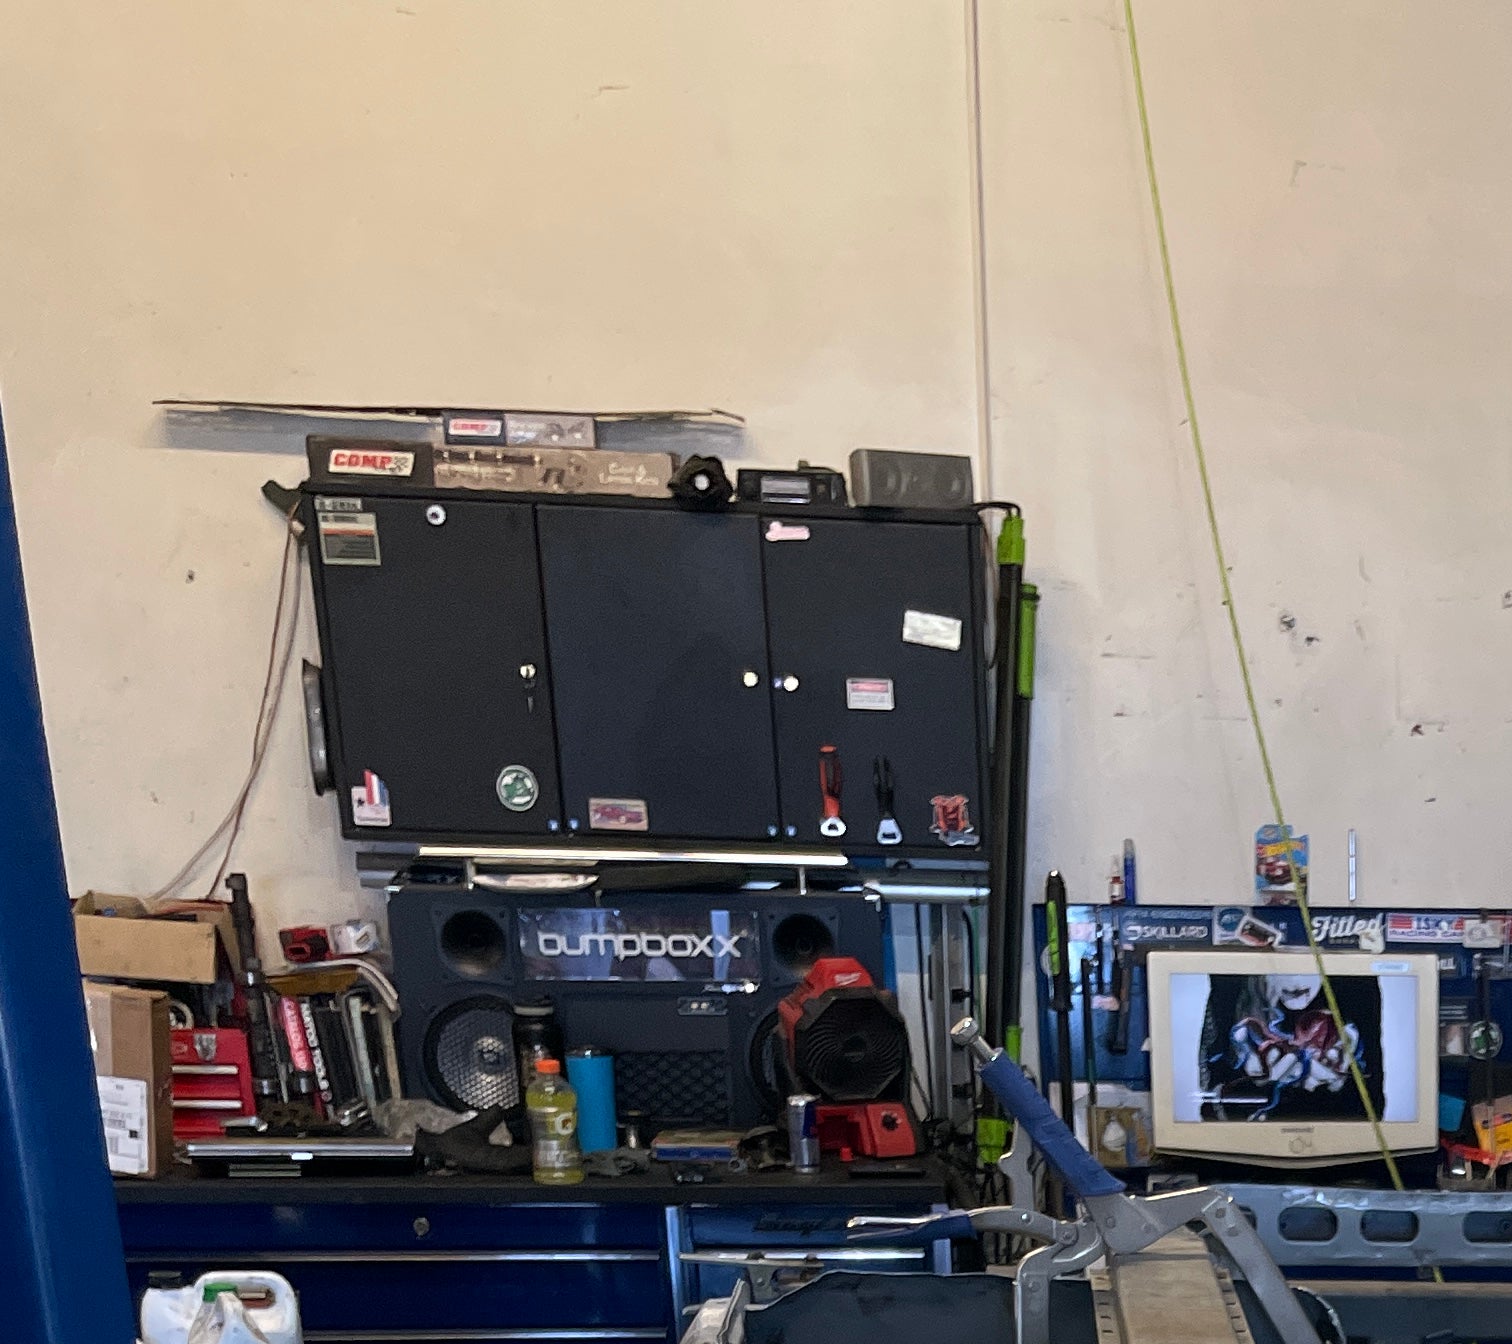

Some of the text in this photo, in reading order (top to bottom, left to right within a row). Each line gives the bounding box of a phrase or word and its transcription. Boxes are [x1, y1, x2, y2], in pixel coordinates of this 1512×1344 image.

[334, 453, 392, 470] COMP
[1142, 925, 1208, 939] SKILLARD
[538, 930, 743, 962] bumpboxx
